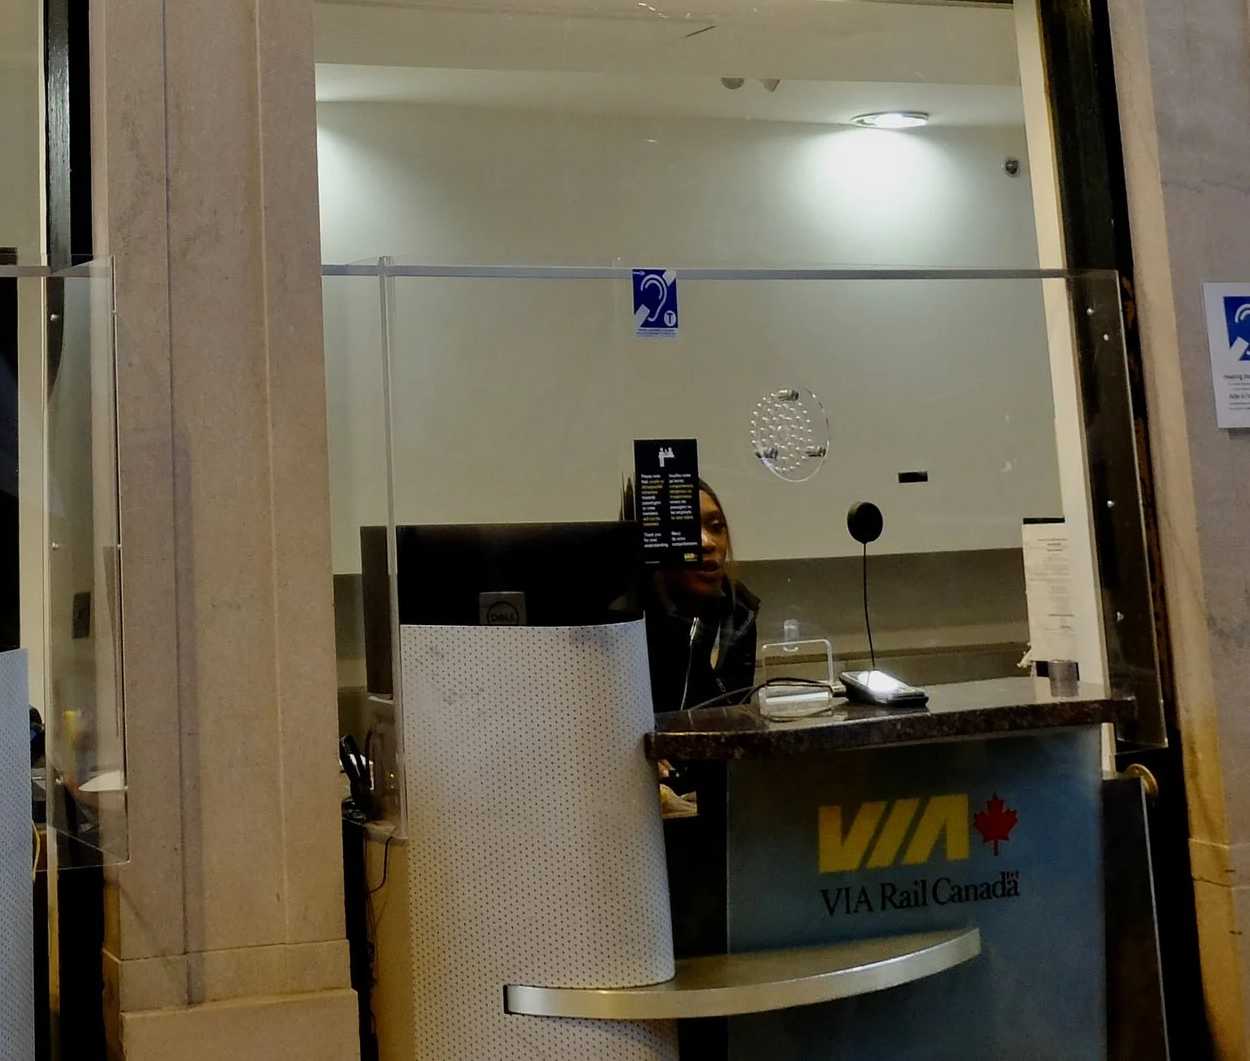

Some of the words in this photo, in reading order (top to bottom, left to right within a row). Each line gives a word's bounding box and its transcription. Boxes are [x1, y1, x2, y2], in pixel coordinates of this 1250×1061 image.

[818, 793, 969, 874] VIA
[820, 885, 874, 916] VIA
[880, 880, 928, 912] Rail
[931, 871, 1020, 906] Canada
